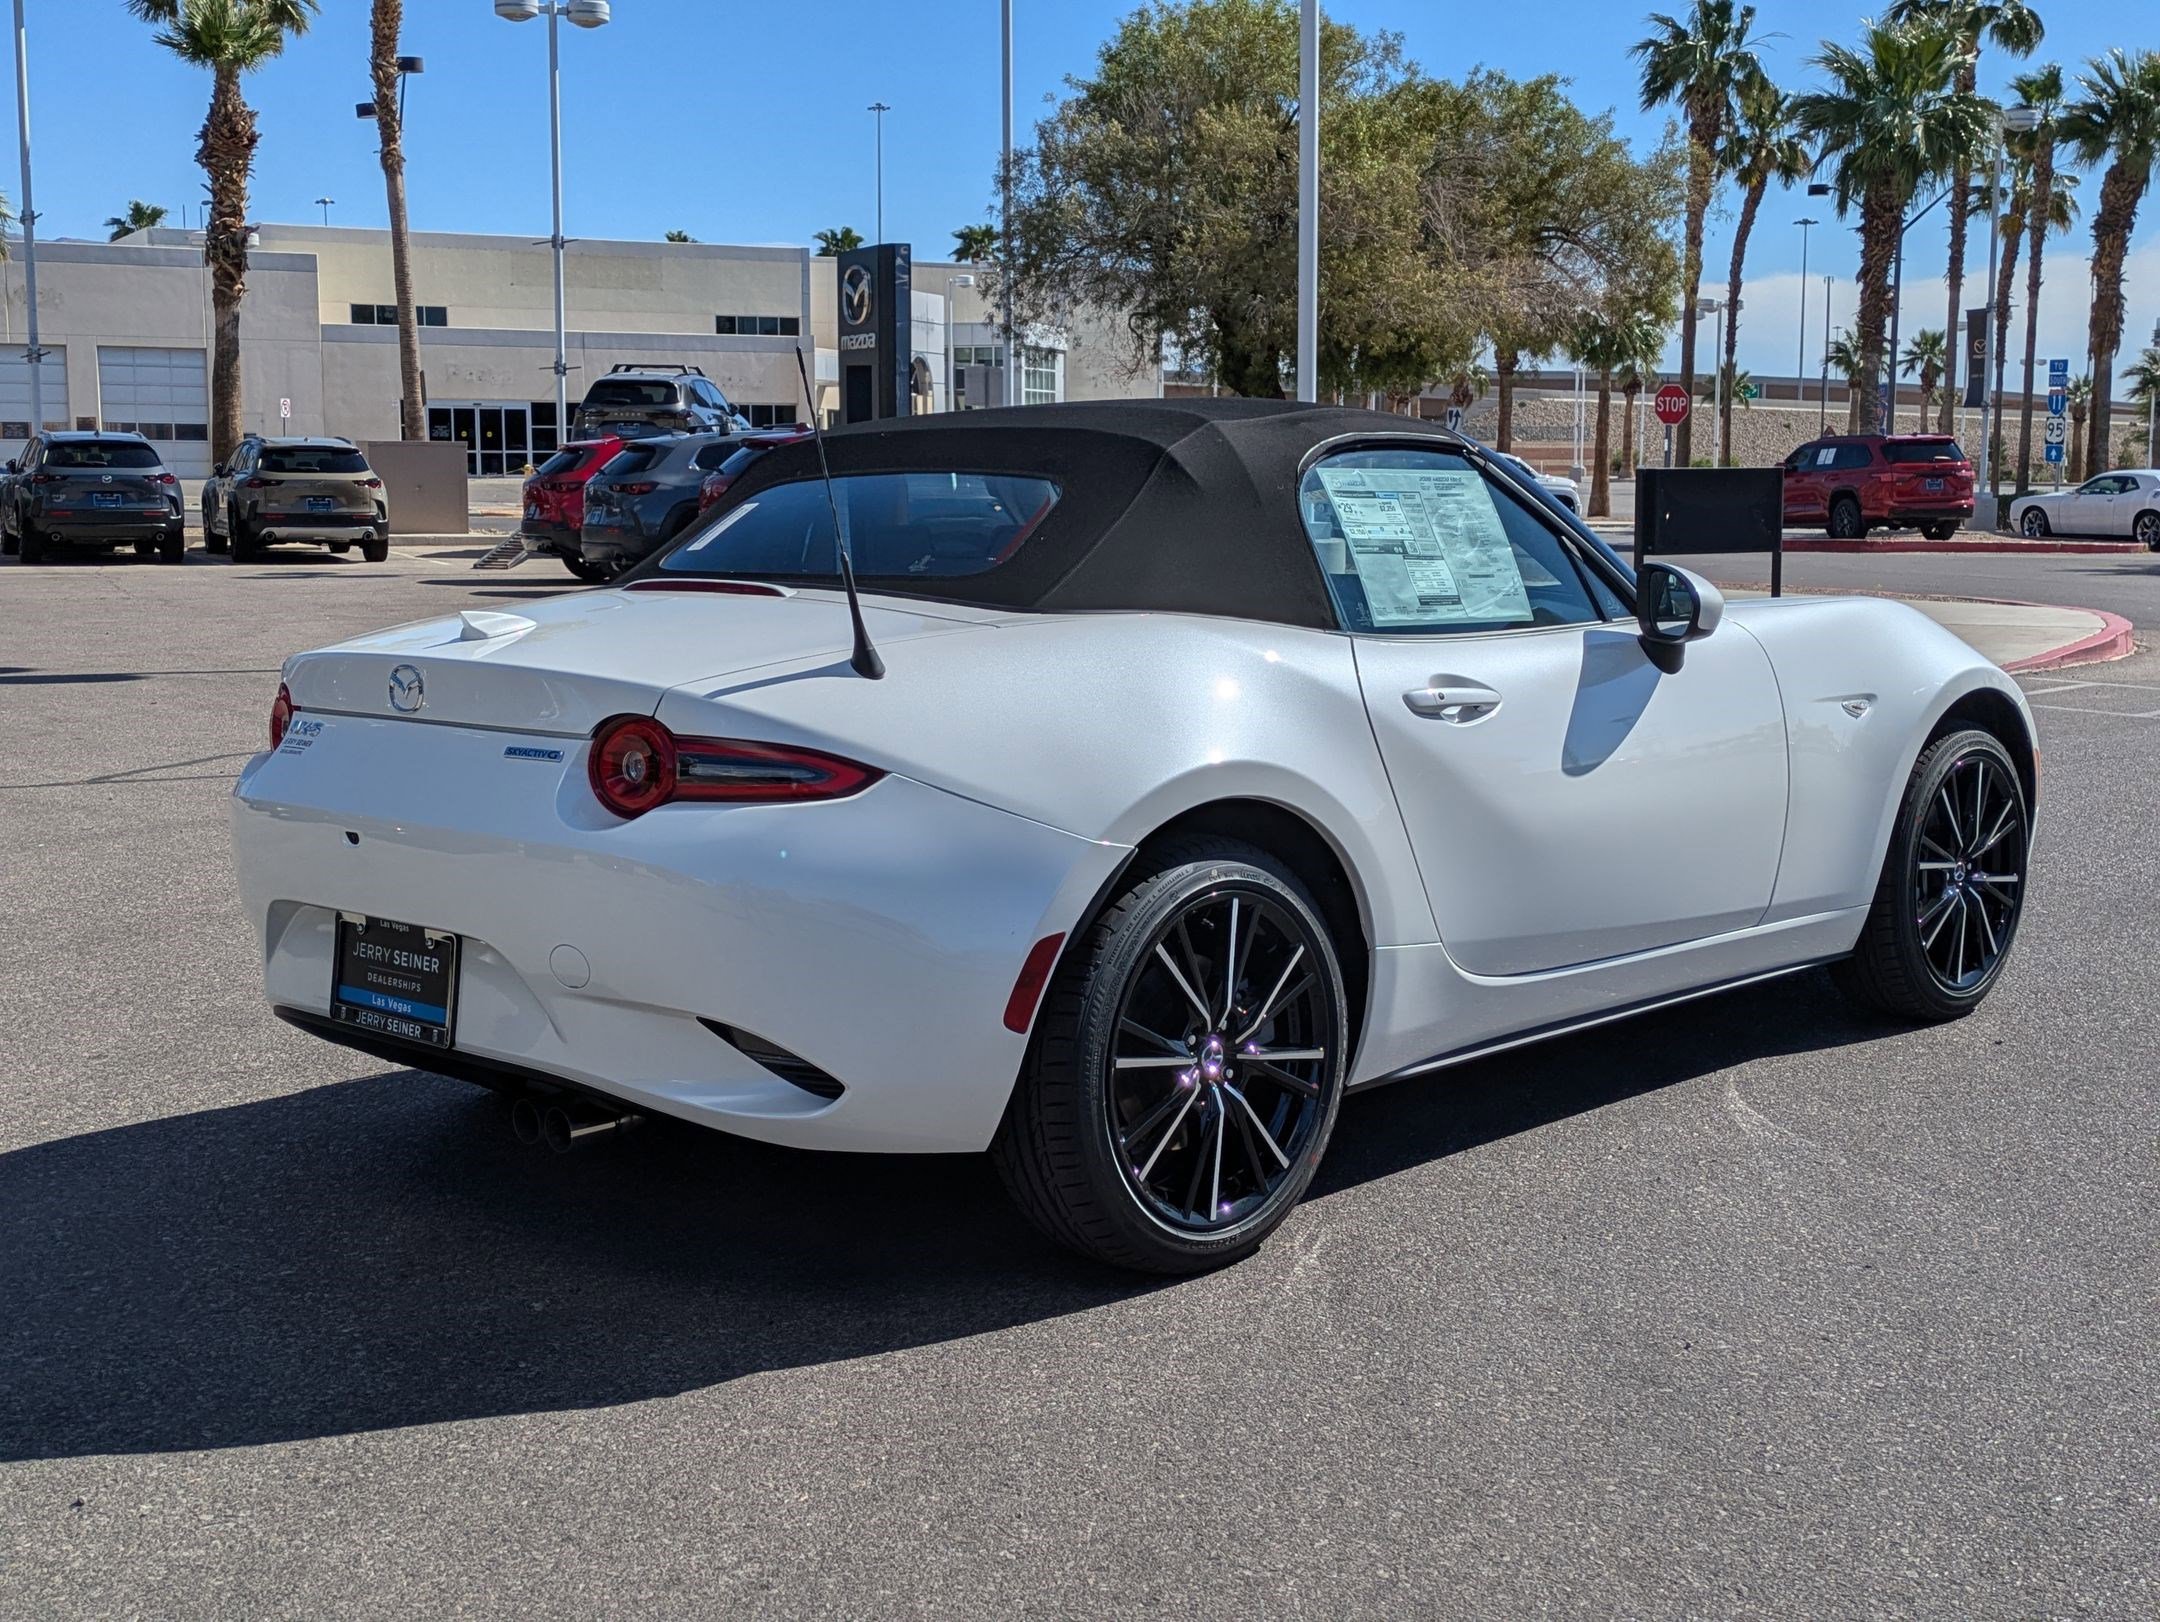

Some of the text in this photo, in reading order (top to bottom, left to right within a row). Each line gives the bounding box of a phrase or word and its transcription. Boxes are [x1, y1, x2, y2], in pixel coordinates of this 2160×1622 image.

[2054, 362, 2064, 370] TO
[2049, 376, 2067, 386] SOUTH
[1657, 397, 1687, 412] STOP
[2052, 395, 2062, 410] 11
[2047, 422, 2064, 438] 95
[380, 920, 410, 933] Las Vegas
[352, 941, 440, 974] JERRY SEINER
[367, 972, 422, 993] DEALERSHIPS
[371, 994, 412, 1013] Las Vegas
[356, 1011, 421, 1039] JERRY SEINER
